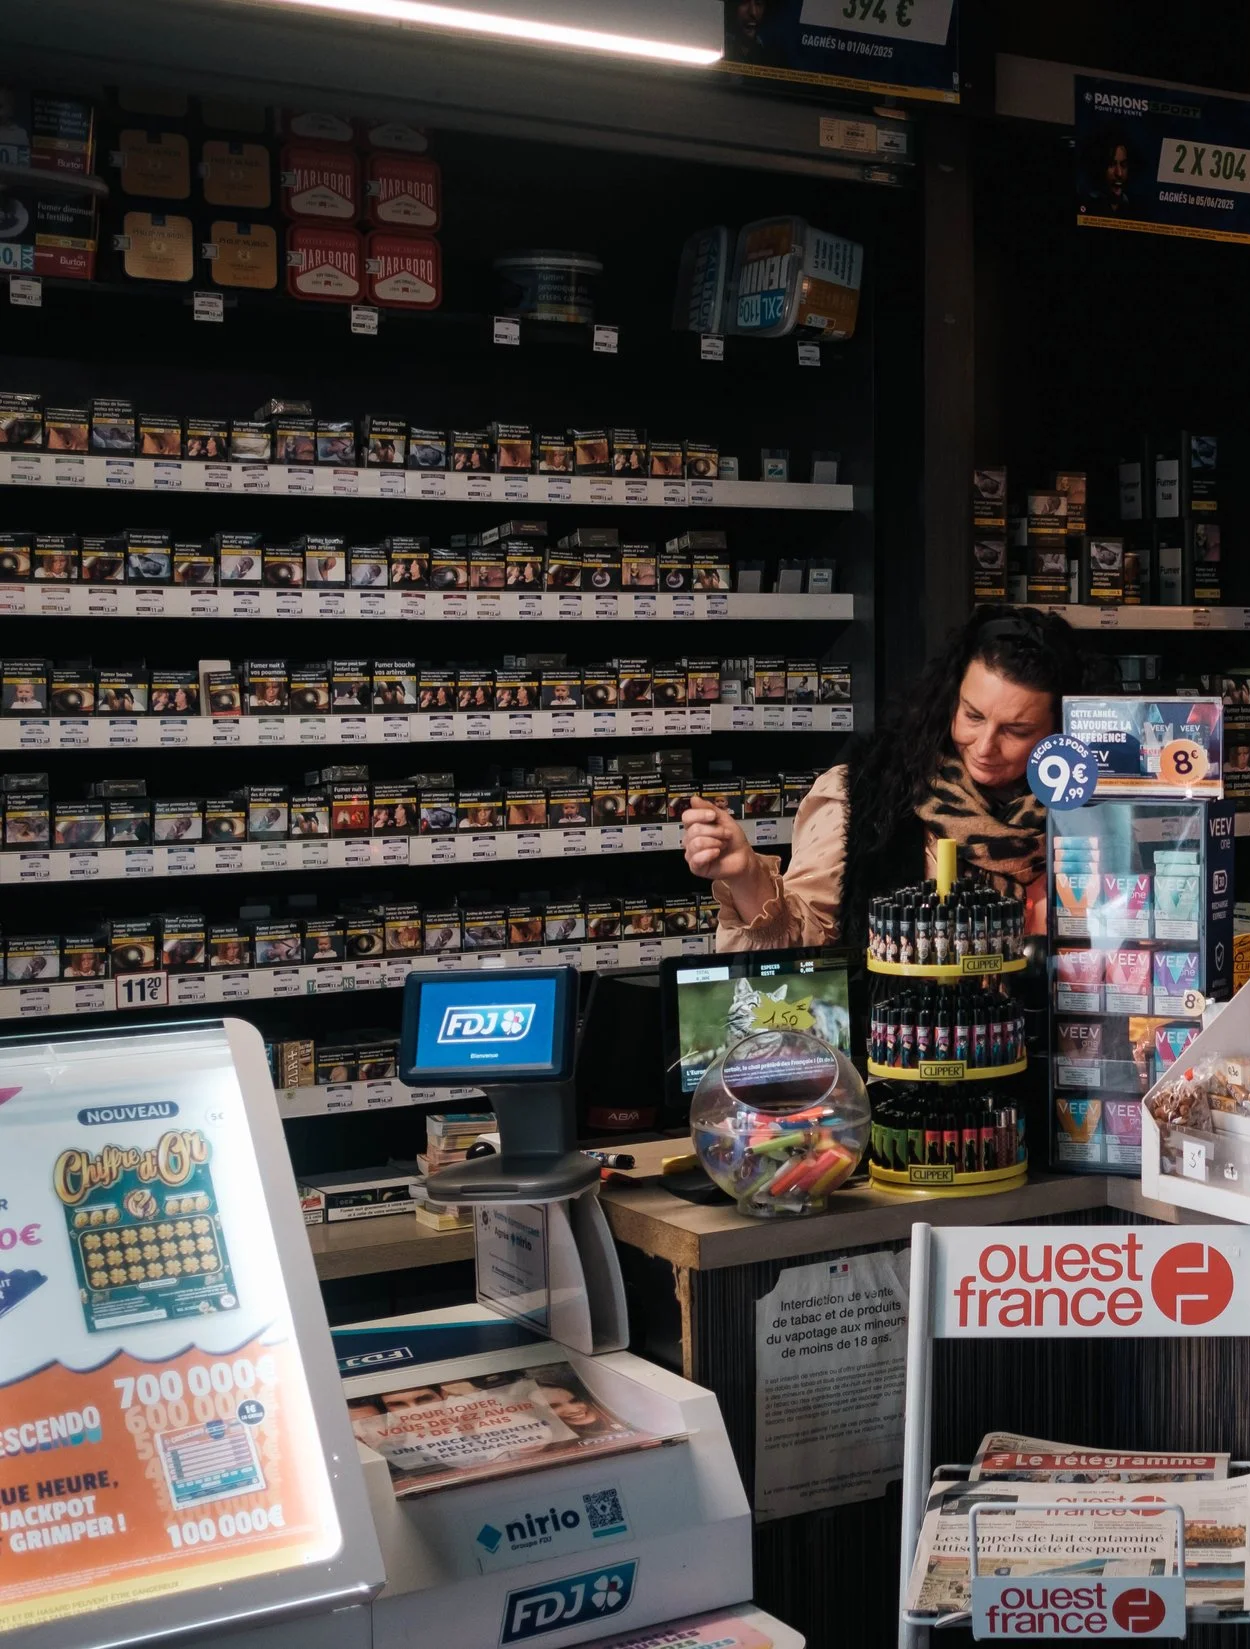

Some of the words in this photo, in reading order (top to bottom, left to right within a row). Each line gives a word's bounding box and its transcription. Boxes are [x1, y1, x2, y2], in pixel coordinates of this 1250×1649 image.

[802, 34, 836, 49] GAGNÉS
[837, 39, 846, 50] le
[847, 42, 893, 58] 01/06/2025
[1094, 92, 1149, 111] PARIONS
[1151, 103, 1200, 117] SPORT
[57, 158, 83, 169] Burton
[1172, 144, 1185, 173] 2
[1190, 146, 1204, 176] X
[1209, 149, 1247, 182] 304
[293, 168, 351, 198] MARLBORO
[379, 179, 433, 209] MARLBORO
[1159, 191, 1187, 204] GAGNÉS
[1188, 195, 1195, 205] le
[37, 202, 62, 212] Fumer
[38, 212, 45, 221] la
[46, 213, 74, 223] fertilité
[60, 256, 86, 267] Burton
[298, 248, 356, 277] MARLBORO
[377, 255, 433, 284] MARLBORO
[1157, 478, 1176, 487] Fumer
[375, 661, 393, 669] Fumer
[394, 661, 416, 669] bouche
[1071, 709, 1092, 718] CETTE
[1071, 720, 1118, 731] SAVOUREZ
[1120, 722, 1132, 731] LA
[1151, 724, 1171, 732] VEEV
[1180, 724, 1200, 732] VEEV
[1071, 731, 1127, 743] DIFFÉRENCE
[1035, 742, 1052, 758] ECIG
[1059, 738, 1064, 746] 2
[1065, 739, 1089, 758] PODS
[1210, 817, 1232, 837] VEEV
[1220, 839, 1231, 849] one
[1105, 878, 1147, 890] VEEV
[966, 959, 999, 970] CLIPPER
[1059, 952, 1098, 964] VEEV
[1107, 953, 1148, 966] VEEV
[1155, 956, 1196, 967] VEEV
[122, 978, 146, 1003] 11
[447, 1010, 499, 1038] FDJ
[1059, 1027, 1098, 1039] VEEV
[923, 1066, 960, 1077] CLIPPER
[87, 1104, 171, 1123] NOUVEAU
[1059, 1102, 1098, 1113] VEEV
[54, 1144, 140, 1205] Chiffre
[913, 1169, 950, 1180] CLIPPER
[979, 1233, 1144, 1284] ouest
[780, 1294, 844, 1312] Interdiction
[847, 1291, 861, 1302] de
[865, 1288, 894, 1300] vente
[953, 1275, 1143, 1328] france
[772, 1318, 787, 1328] de
[791, 1313, 822, 1326] tabac
[825, 1310, 836, 1321] et
[839, 1307, 854, 1318] de
[857, 1301, 901, 1318] produits
[766, 1334, 782, 1345] du
[785, 1327, 838, 1343] vapotage
[840, 1324, 861, 1334] aux
[864, 1316, 906, 1331] mineurs
[781, 1348, 796, 1359] de
[800, 1343, 834, 1356] moins
[837, 1339, 850, 1350] de
[855, 1336, 868, 1347] 18
[871, 1334, 892, 1346] ans.
[114, 1370, 184, 1409] 700
[187, 1356, 278, 1395] 000€
[125, 1398, 190, 1434] 600
[377, 1420, 428, 1438] VOUS
[428, 1411, 480, 1428] DEVEZ
[480, 1402, 535, 1419] AVOIR
[400, 1409, 447, 1424] POUR
[431, 1426, 453, 1438] DE
[456, 1423, 476, 1434] 18
[477, 1416, 512, 1429] ANS
[392, 1444, 427, 1456] UNE
[428, 1435, 469, 1452] PIÈCE
[437, 1440, 476, 1453] PEUT
[477, 1433, 519, 1447] VOUS
[459, 1434, 545, 1458] DEMANDÉE
[1015, 1453, 1043, 1466] Le
[1051, 1451, 1207, 1469] Télégramme
[37, 1470, 120, 1499] HEURE,
[0, 1495, 96, 1531] JACKPOT
[10, 1516, 115, 1553] GRIMPER
[117, 1513, 127, 1532] !
[167, 1520, 216, 1549] 100
[218, 1504, 286, 1540] 000€
[505, 1507, 580, 1542] nirio
[511, 1539, 538, 1551] Groupe
[935, 1533, 961, 1543] Les
[1027, 1533, 1046, 1543] de
[1050, 1533, 1074, 1543] lait
[1078, 1533, 1164, 1543] contaminé
[993, 1542, 1061, 1553] l'anxiété
[1065, 1543, 1091, 1553] des
[1095, 1543, 1157, 1554] parents
[1000, 1582, 1107, 1610] ouest
[511, 1583, 587, 1634] FDJ
[985, 1605, 1108, 1634] france
